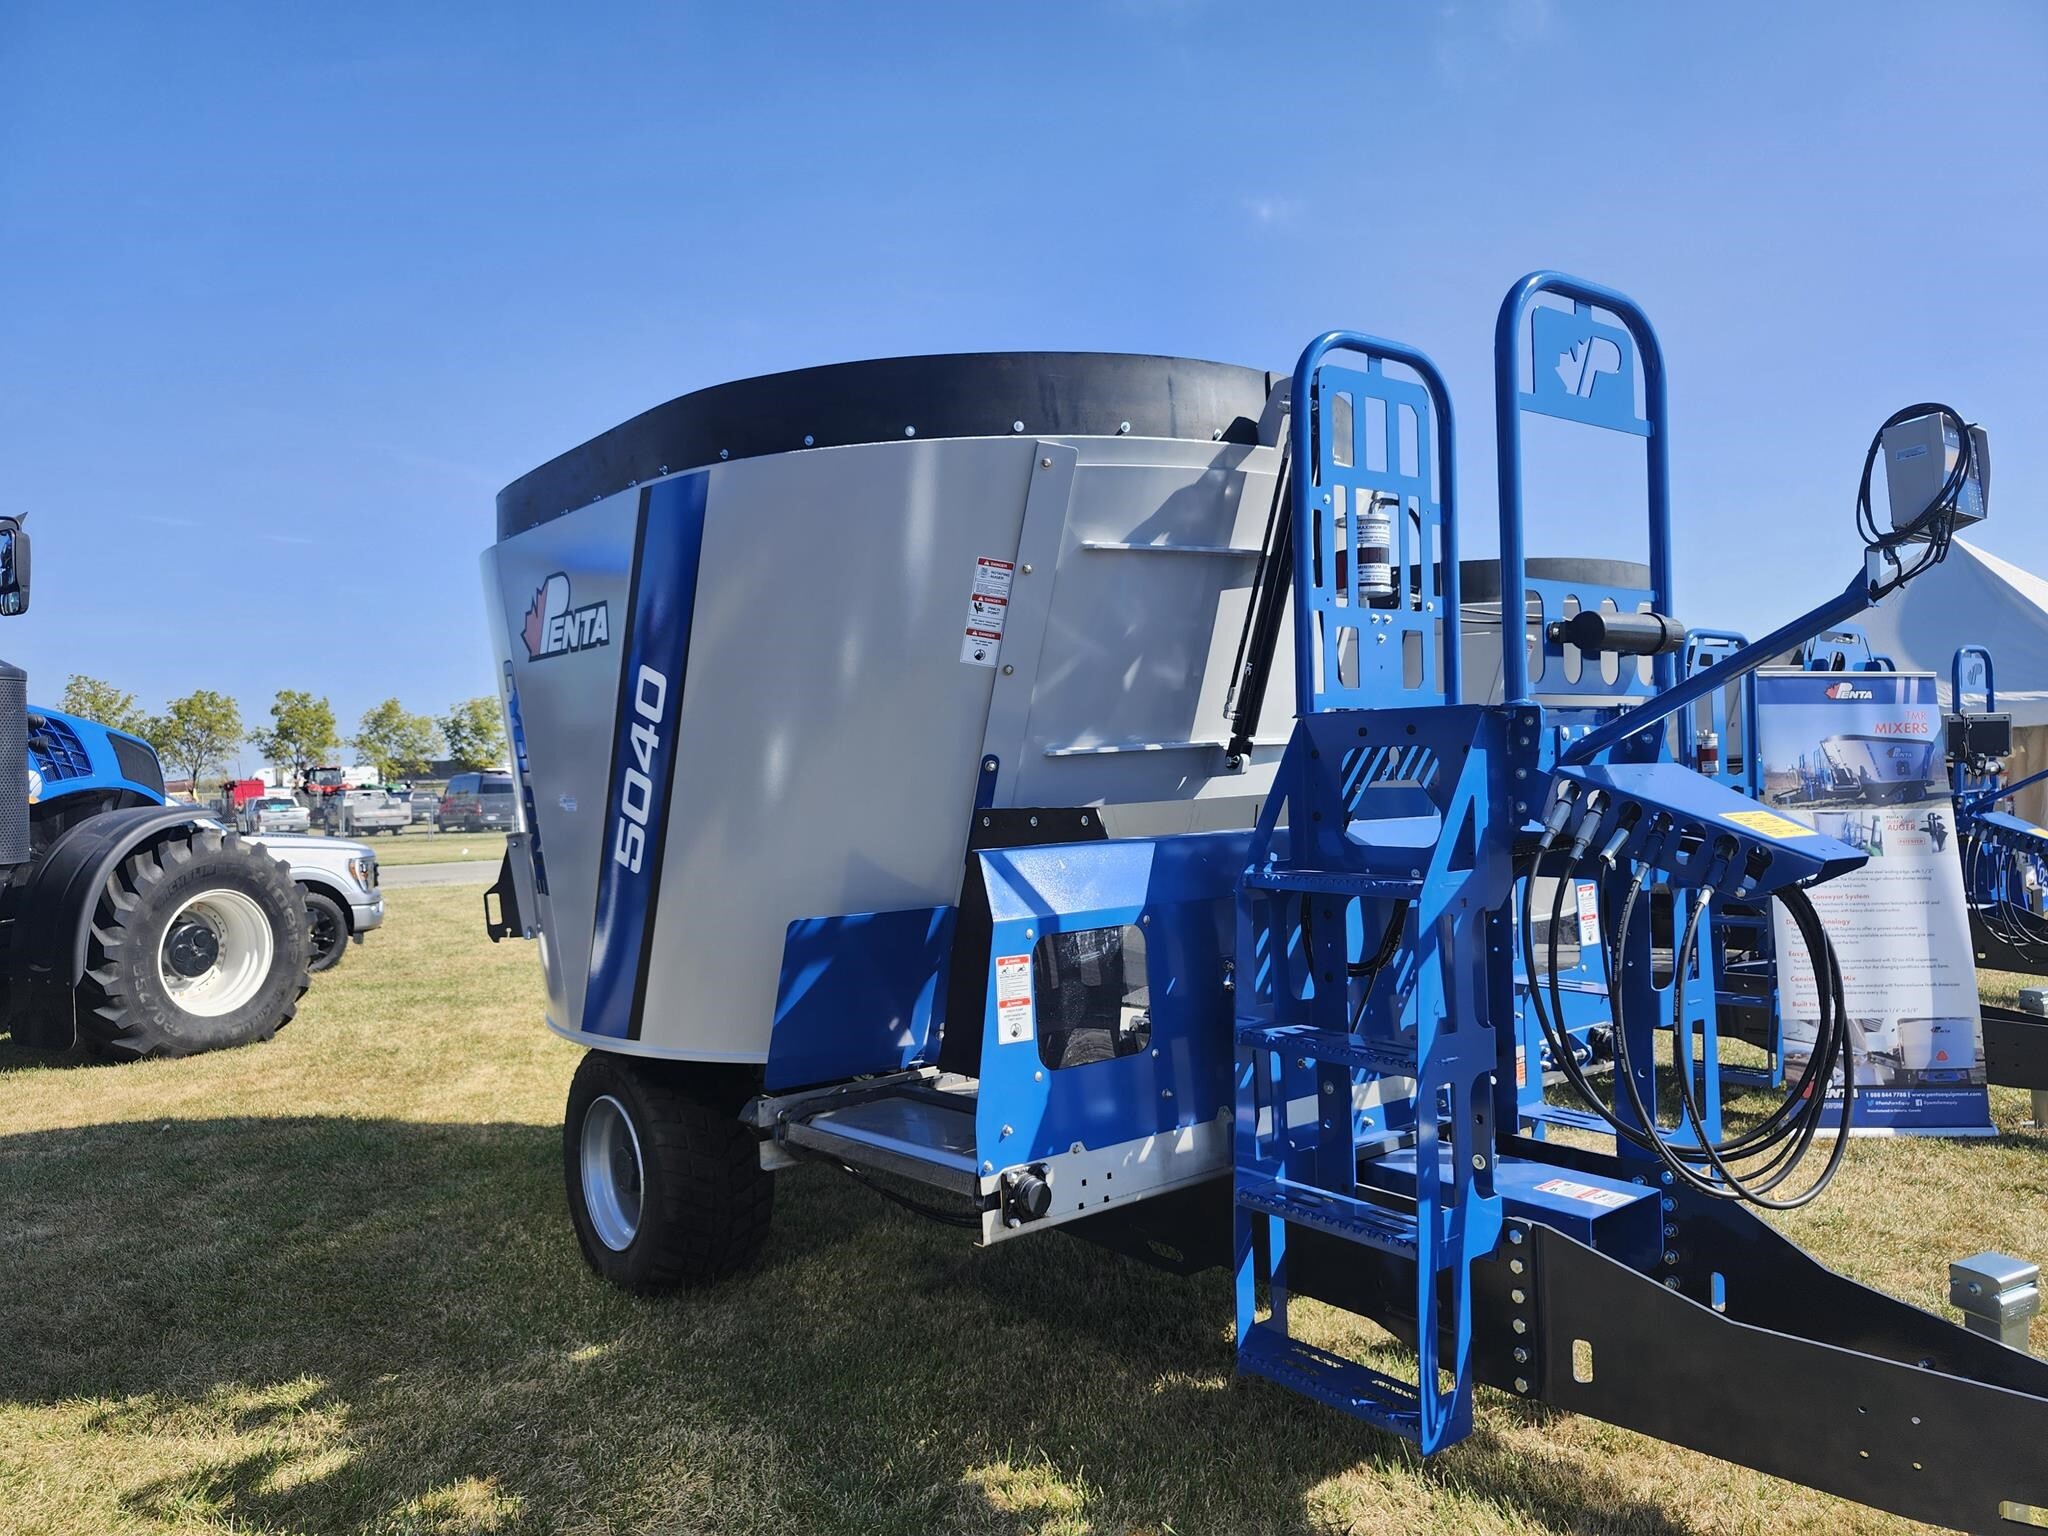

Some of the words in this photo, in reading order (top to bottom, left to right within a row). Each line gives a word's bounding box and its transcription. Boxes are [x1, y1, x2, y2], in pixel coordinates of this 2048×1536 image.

[534, 571, 610, 661] PENTA
[1835, 682, 1873, 699] PENTA
[1905, 711, 1926, 720] TMR
[1875, 722, 1928, 733] MIXERS
[614, 664, 667, 874] 5040
[1887, 823, 1916, 831] AUGER
